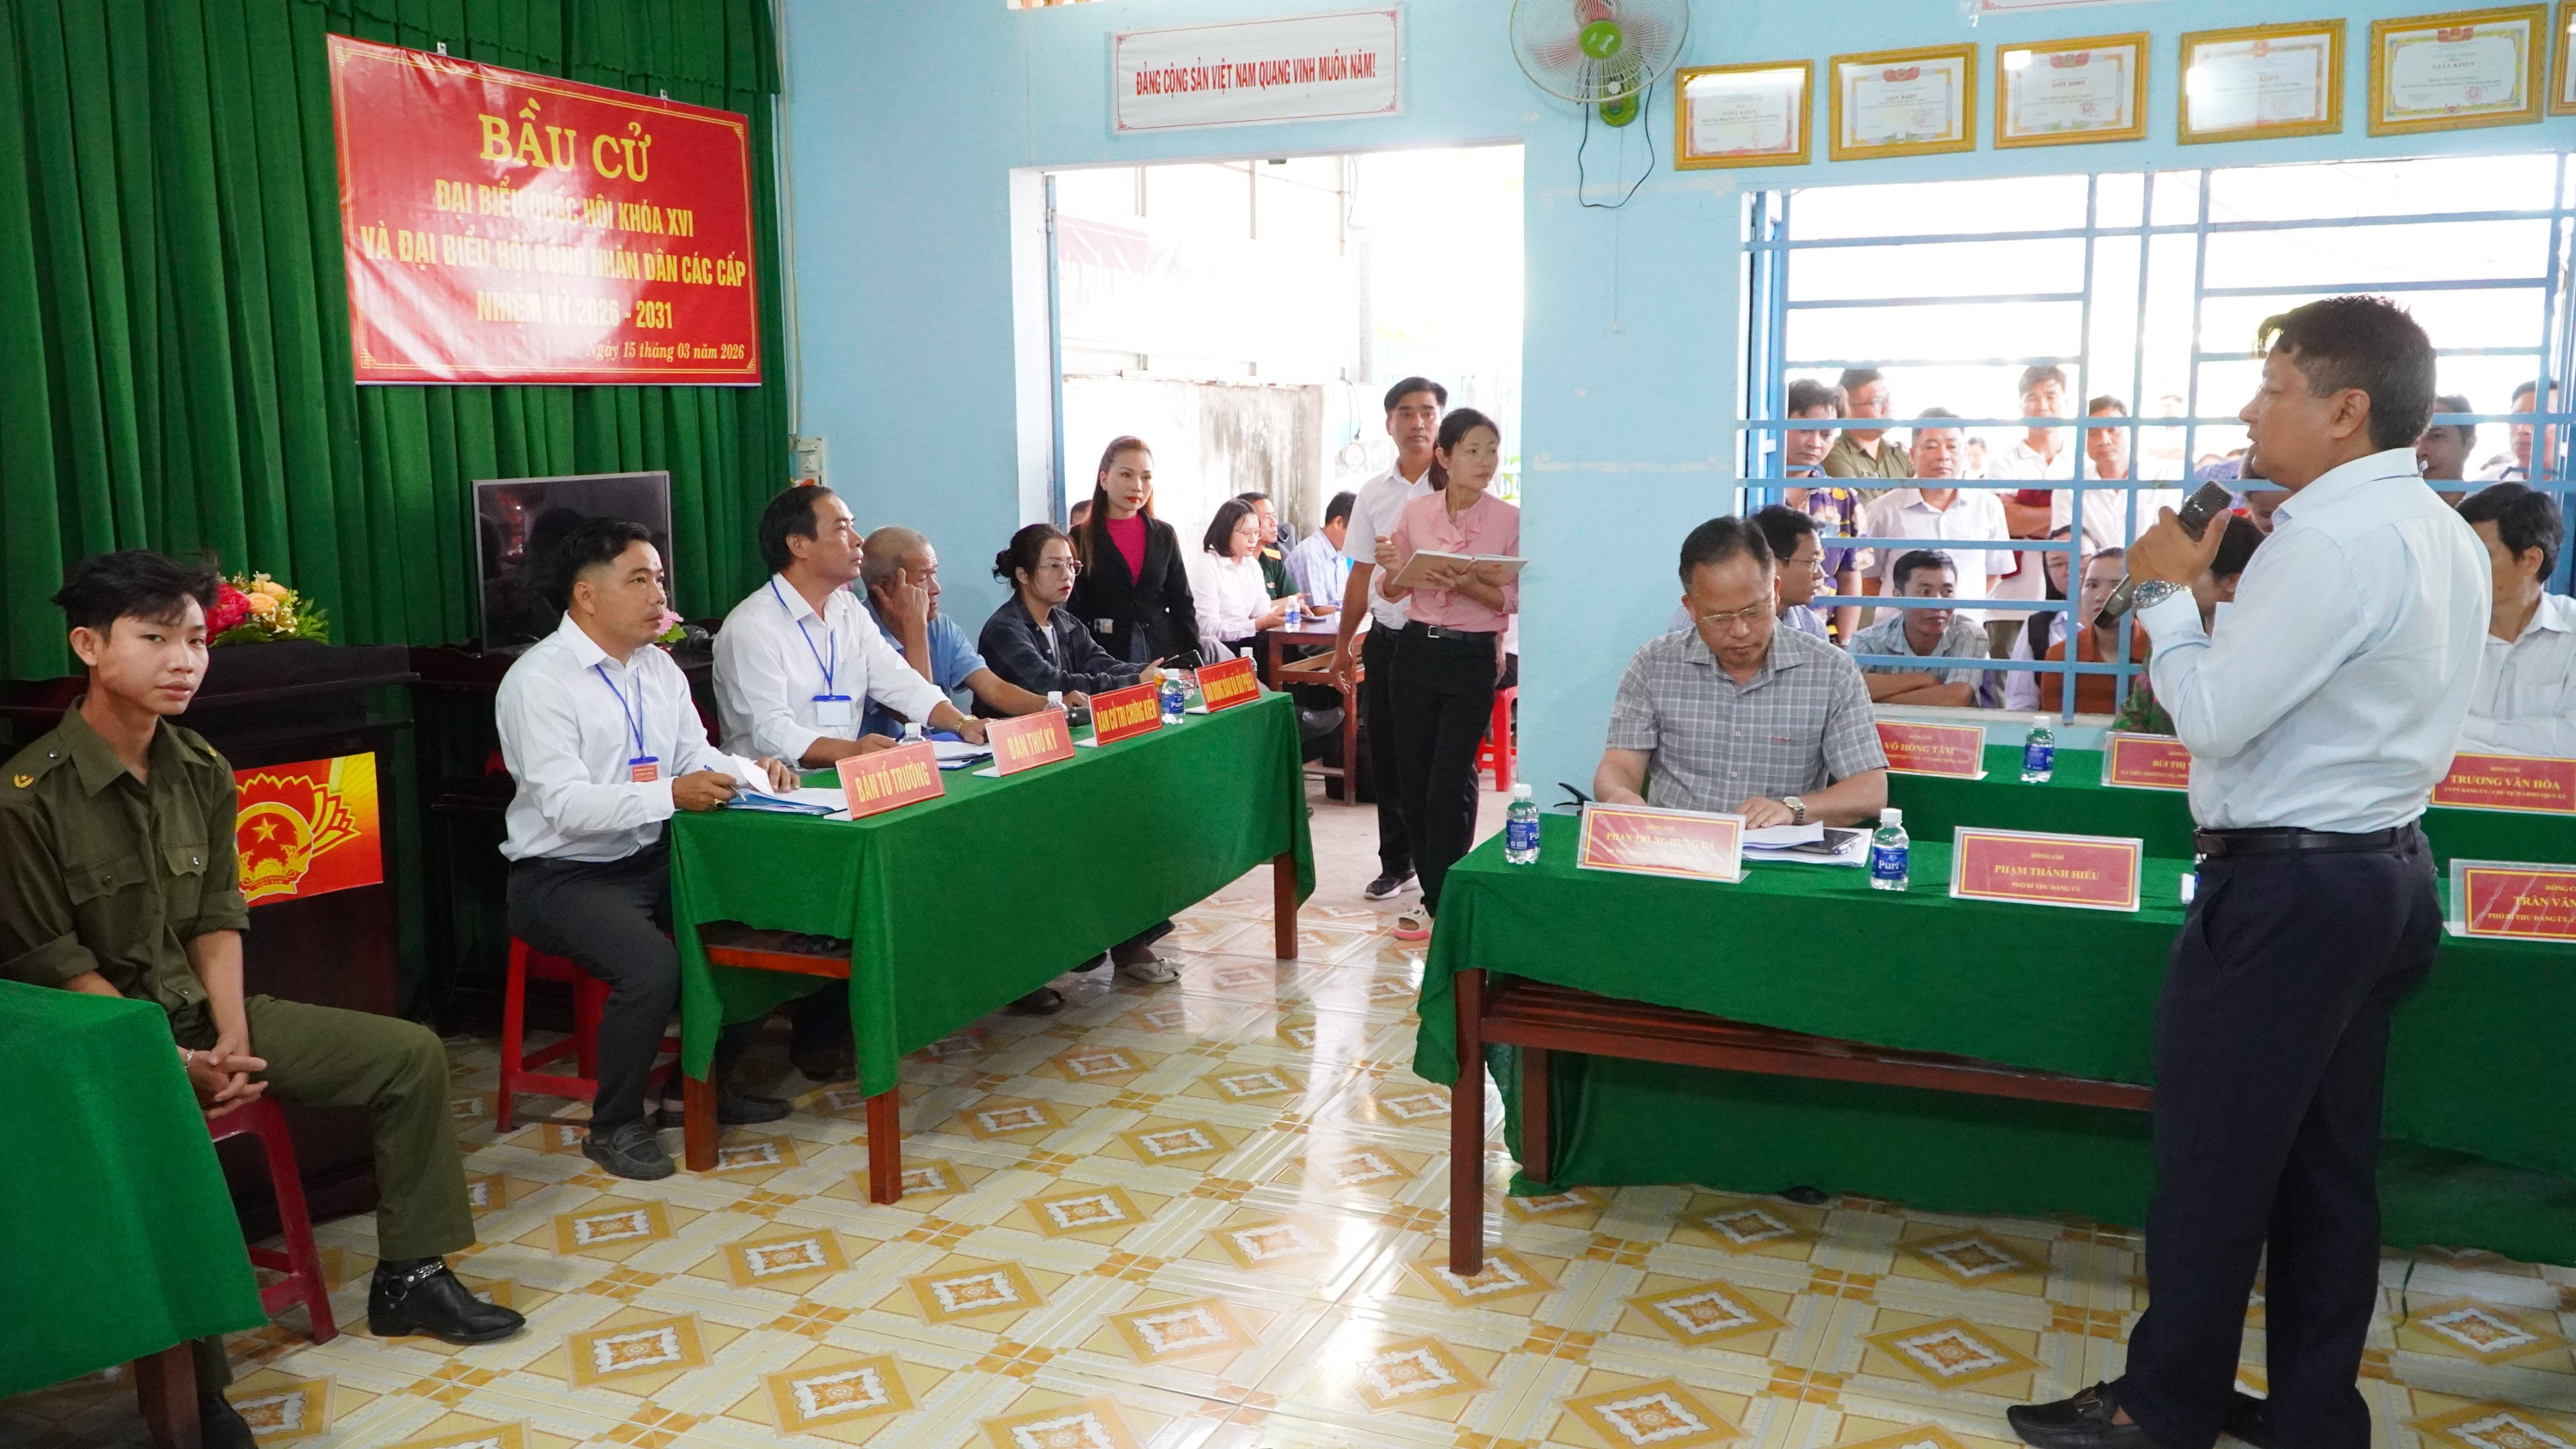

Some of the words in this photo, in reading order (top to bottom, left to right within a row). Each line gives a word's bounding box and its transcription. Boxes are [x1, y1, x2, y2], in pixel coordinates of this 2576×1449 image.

[1136, 61, 1161, 96] ĐẢNG
[1163, 62, 1188, 99] CỘNG
[1190, 57, 1209, 92] SẢN
[1212, 58, 1232, 95] VIỆT
[1235, 63, 1256, 88] NAM
[1259, 59, 1290, 91] QUANG
[1292, 58, 1315, 84] VINH
[1319, 49, 1347, 82] MUÔN
[1350, 48, 1376, 79] NĂM!
[478, 97, 576, 172] BẦU
[592, 121, 652, 182] CỬ
[435, 179, 471, 221] ĐẠI
[479, 175, 522, 218] BIỂU
[528, 185, 579, 227] QUỐC
[583, 195, 613, 235] HỘI
[619, 192, 663, 236] KHÓA
[666, 208, 694, 238] XVI
[361, 221, 392, 261] VÀ
[398, 229, 436, 272] ĐẠI
[442, 226, 490, 268] BIỂU
[495, 237, 532, 277] HỘI
[590, 243, 640, 281] NHÂN
[643, 246, 678, 284] DÂN
[681, 251, 713, 286] CÁC
[716, 251, 746, 288] CẤP
[477, 289, 543, 330] NHIỆM
[577, 298, 620, 327] 2026
[635, 301, 673, 330] 2031
[586, 342, 619, 362] Ngày
[623, 343, 637, 358] 15
[641, 343, 674, 363] tháng
[677, 343, 690, 359] 03
[693, 343, 718, 360] năm
[720, 343, 745, 360] 2026
[1007, 732, 1029, 760] BÀN
[1029, 727, 1047, 755] THƯ
[855, 770, 879, 803] BÀN
[877, 761, 894, 797] TỔ
[890, 756, 932, 794] TRƯỞNG
[2505, 776, 2530, 788] VĂN
[1607, 832, 1632, 842] PHAN
[1878, 859, 1899, 870] Puri
[1995, 864, 2027, 876] PHẠM
[2551, 896, 2576, 908] VĂN
